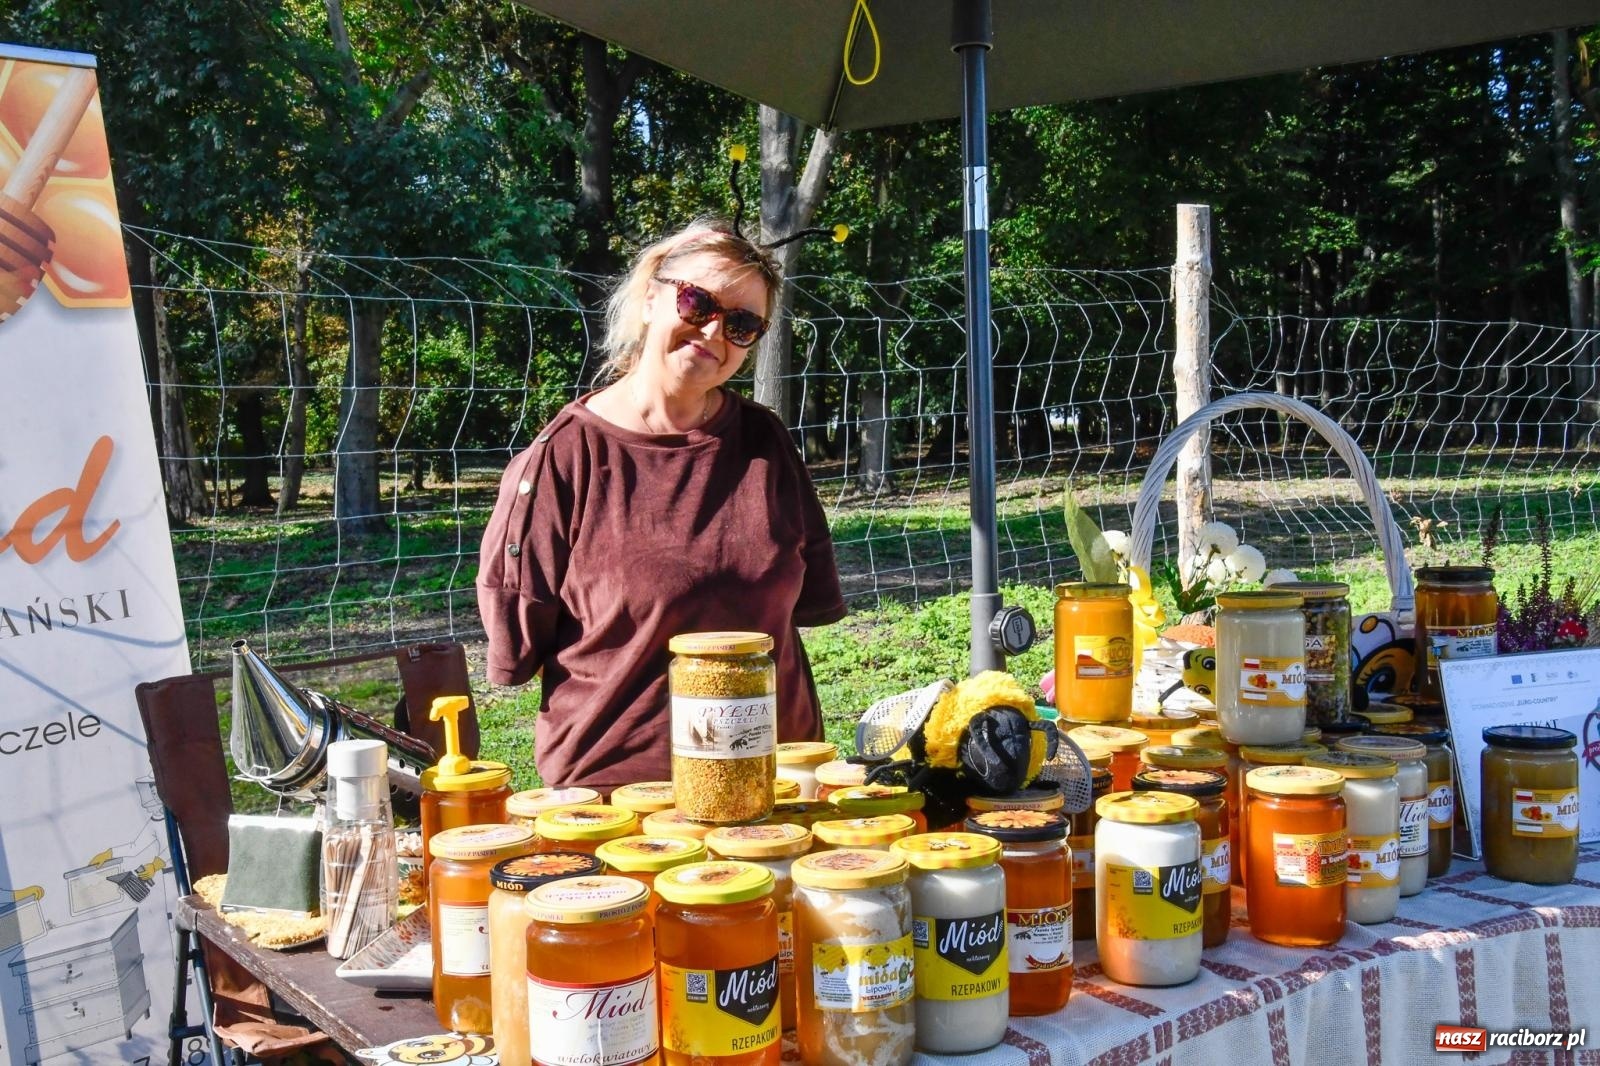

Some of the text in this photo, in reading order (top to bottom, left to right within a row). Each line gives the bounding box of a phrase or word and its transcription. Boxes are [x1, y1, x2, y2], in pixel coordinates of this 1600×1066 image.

[0, 435, 121, 565] d
[1210, 853, 1229, 868] MIÓ
[496, 880, 524, 891] MIÓD
[939, 915, 1000, 954] Miód
[720, 960, 778, 1007] Miód
[951, 978, 1001, 996] RZEPAKOWY
[552, 977, 650, 1021] Miód
[732, 1026, 778, 1051] RZEPAKOWY
[557, 1043, 651, 1066] wielokwiatowy
